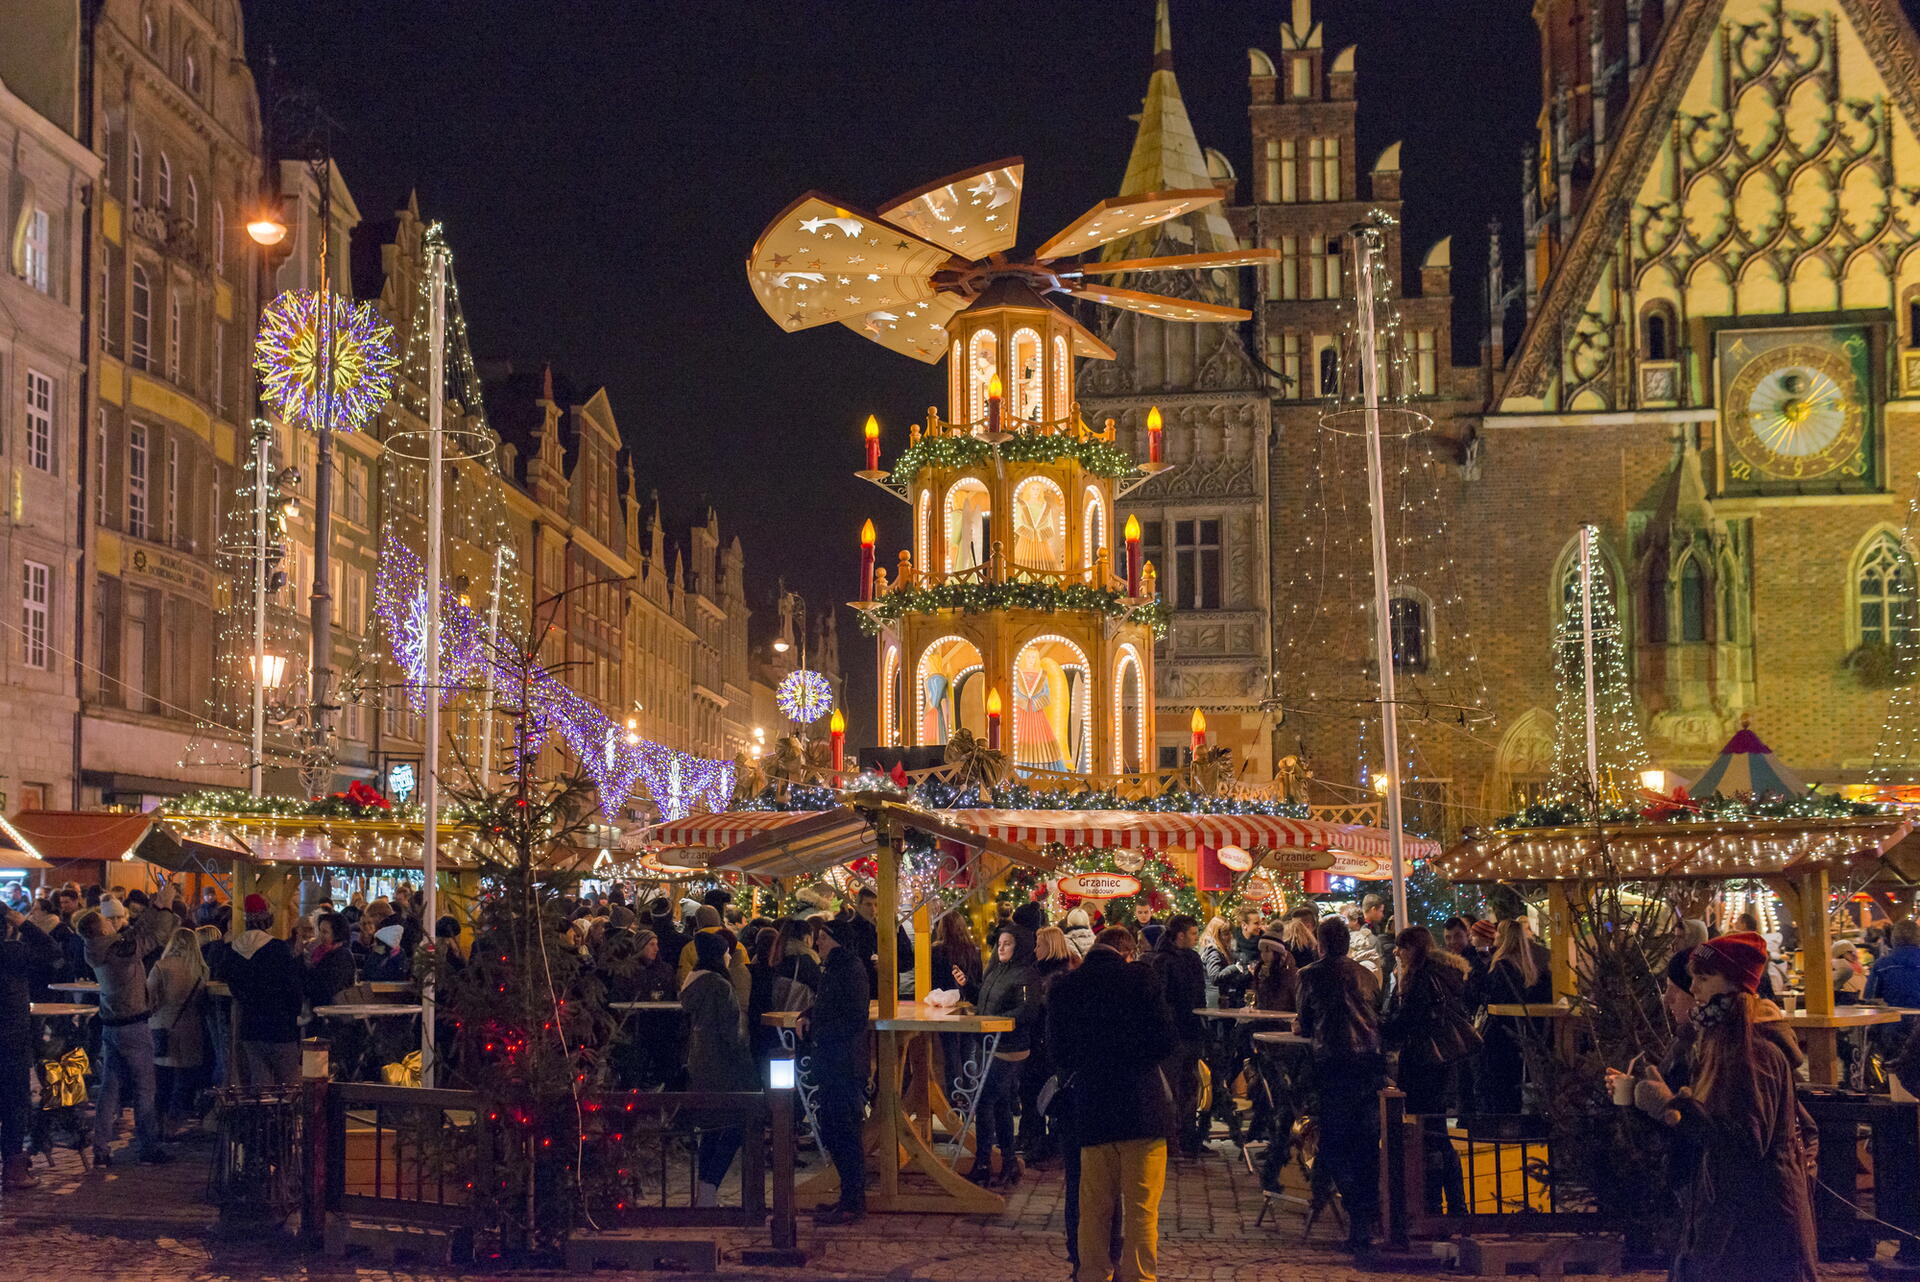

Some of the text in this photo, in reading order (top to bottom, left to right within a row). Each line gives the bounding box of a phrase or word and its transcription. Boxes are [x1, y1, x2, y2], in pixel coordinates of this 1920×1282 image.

[680, 850, 711, 859] Grzani
[1274, 852, 1316, 862] Grzaniec
[1336, 857, 1369, 867] rzaniec
[1079, 878, 1121, 888] Grzaniec
